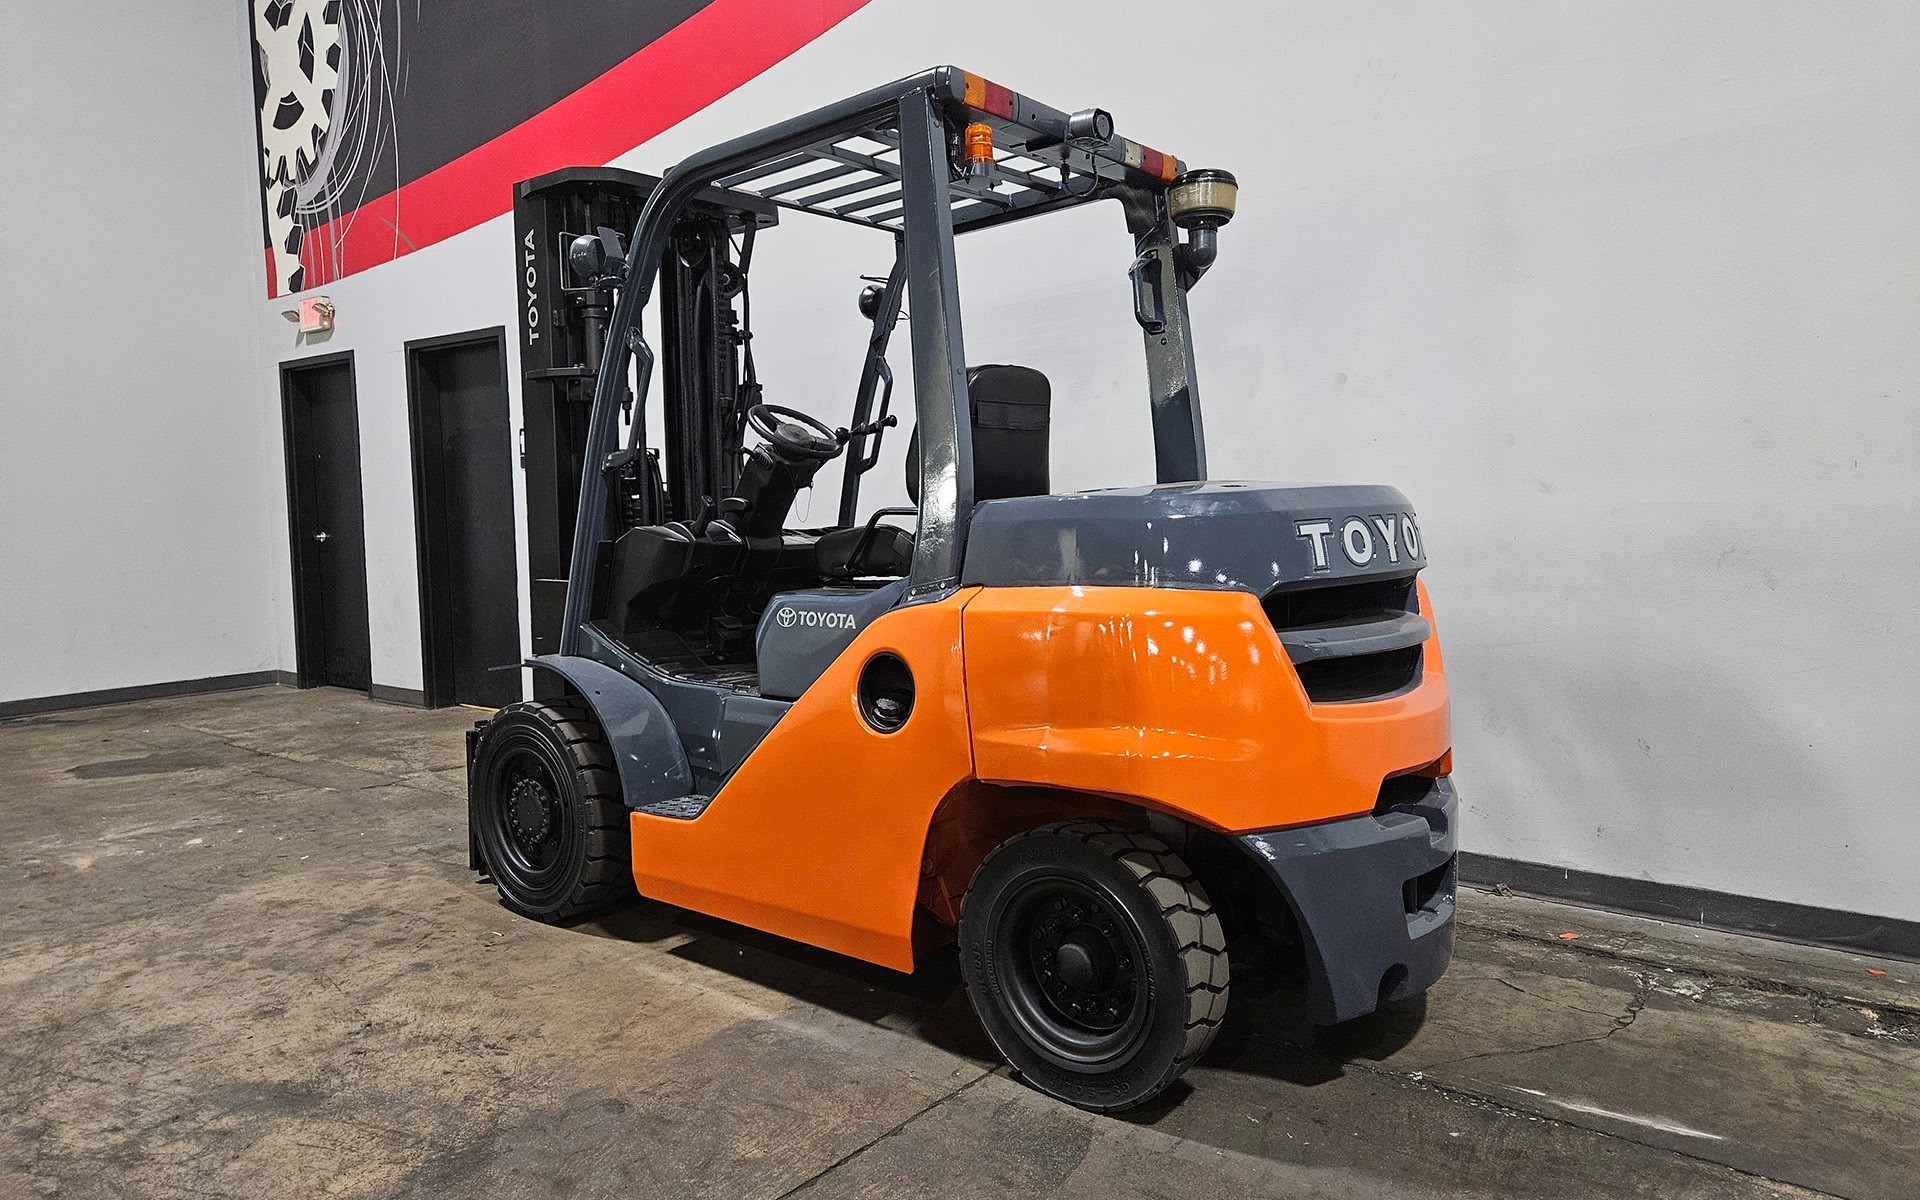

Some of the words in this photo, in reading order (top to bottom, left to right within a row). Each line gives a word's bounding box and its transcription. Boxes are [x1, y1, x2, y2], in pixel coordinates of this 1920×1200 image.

[524, 228, 539, 346] TOYOTA
[1294, 513, 1421, 572] TOYO
[798, 610, 856, 630] TOYOTA
